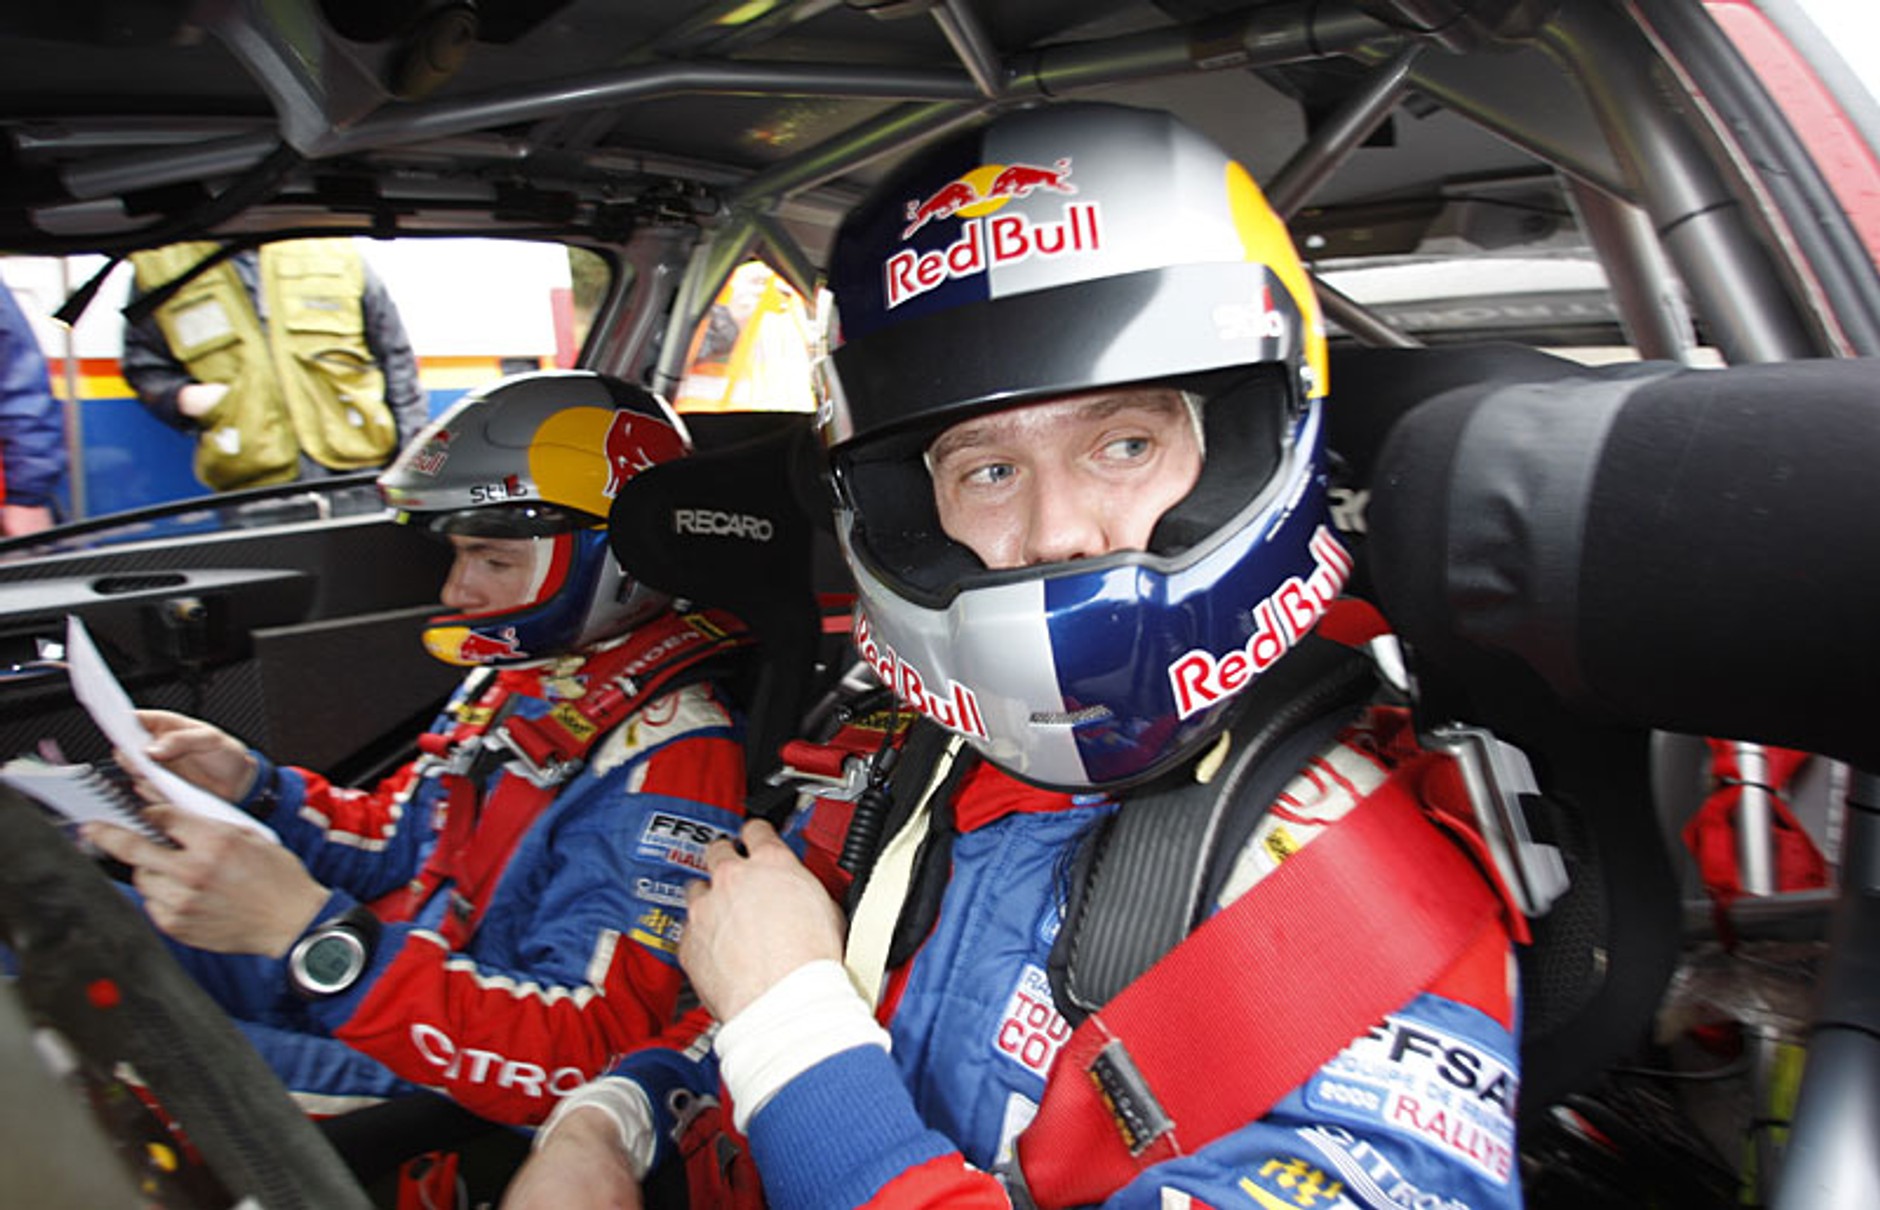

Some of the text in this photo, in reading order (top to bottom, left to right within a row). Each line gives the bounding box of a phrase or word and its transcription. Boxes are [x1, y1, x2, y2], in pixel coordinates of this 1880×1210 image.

[888, 205, 1100, 303] Red Bull
[675, 508, 773, 541] RECARO
[1173, 529, 1356, 714] Red Bull
[900, 659, 986, 738] Bull
[1368, 1020, 1512, 1114] FSA
[1394, 1093, 1511, 1181] RALLYE
